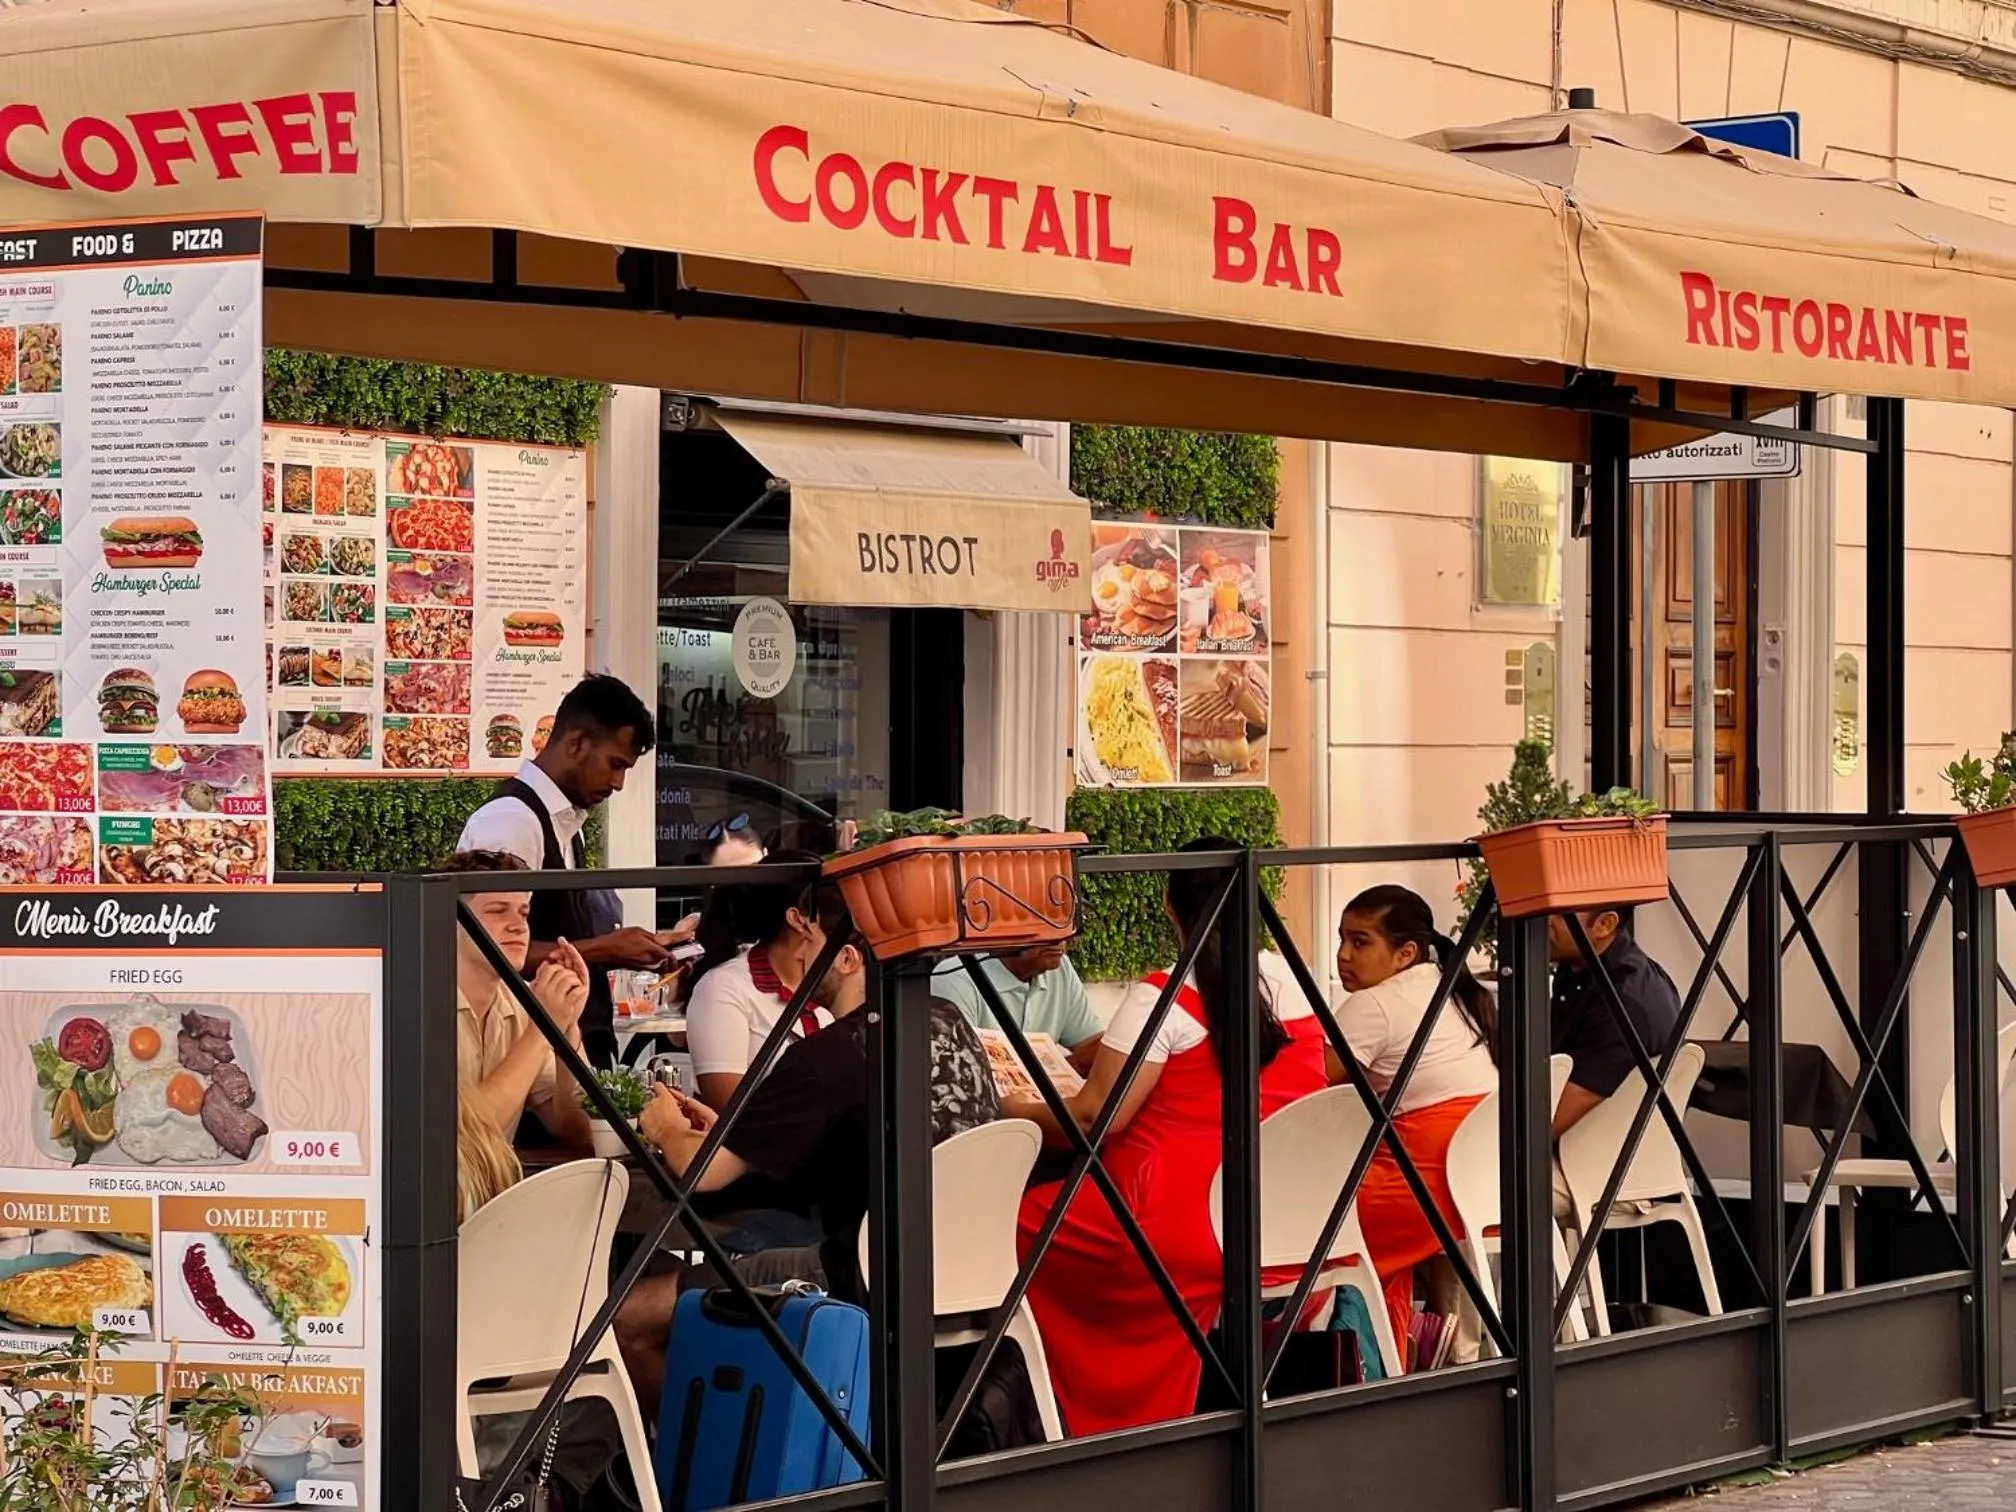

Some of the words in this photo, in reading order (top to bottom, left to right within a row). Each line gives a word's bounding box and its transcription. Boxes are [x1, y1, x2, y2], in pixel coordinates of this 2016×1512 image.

[0, 91, 359, 193] COFFEE
[753, 124, 1133, 268] COCKTAIL
[1211, 195, 1344, 298] BAR
[72, 236, 118, 257] FOOD
[122, 233, 134, 254] &
[172, 228, 223, 250] PIZZA
[124, 274, 172, 300] Panino
[1679, 271, 1971, 372] RISTORANTE
[1667, 443, 1743, 458] autorizzati
[1492, 524, 1551, 547] VIRGINIA
[857, 532, 978, 576] BISTROT
[91, 572, 157, 597] Hamburger
[159, 572, 200, 595] Special
[745, 604, 783, 620] PREMIUM
[1091, 633, 1127, 645] American
[748, 649, 756, 660] &
[759, 649, 780, 660] BAR
[751, 680, 781, 693] QUALITY
[1212, 764, 1232, 777] Toast
[59, 798, 92, 810] 13,00€
[228, 800, 263, 813] 13,00€
[14, 899, 90, 938] Menù
[93, 898, 219, 945] Breakfast
[110, 970, 150, 984] FRIED
[153, 970, 182, 984] EGG
[287, 1142, 325, 1158] 9,00
[330, 1142, 340, 1156] €
[89, 1178, 118, 1190] FRIED
[120, 1179, 144, 1192] EGG,
[190, 1181, 225, 1192] SALAD
[2, 1202, 111, 1224] OMELETTE
[205, 1208, 328, 1228] OMELETTE
[101, 1314, 126, 1327] 9,00
[127, 1315, 135, 1326] €
[308, 1322, 332, 1336] 9,00
[335, 1322, 344, 1334] €
[228, 1352, 264, 1361] OMELETTE
[303, 1354, 331, 1363] VEGGIE
[251, 1374, 361, 1395] BREAKFAST
[309, 1488, 333, 1501] 7,00
[335, 1488, 343, 1499] €
